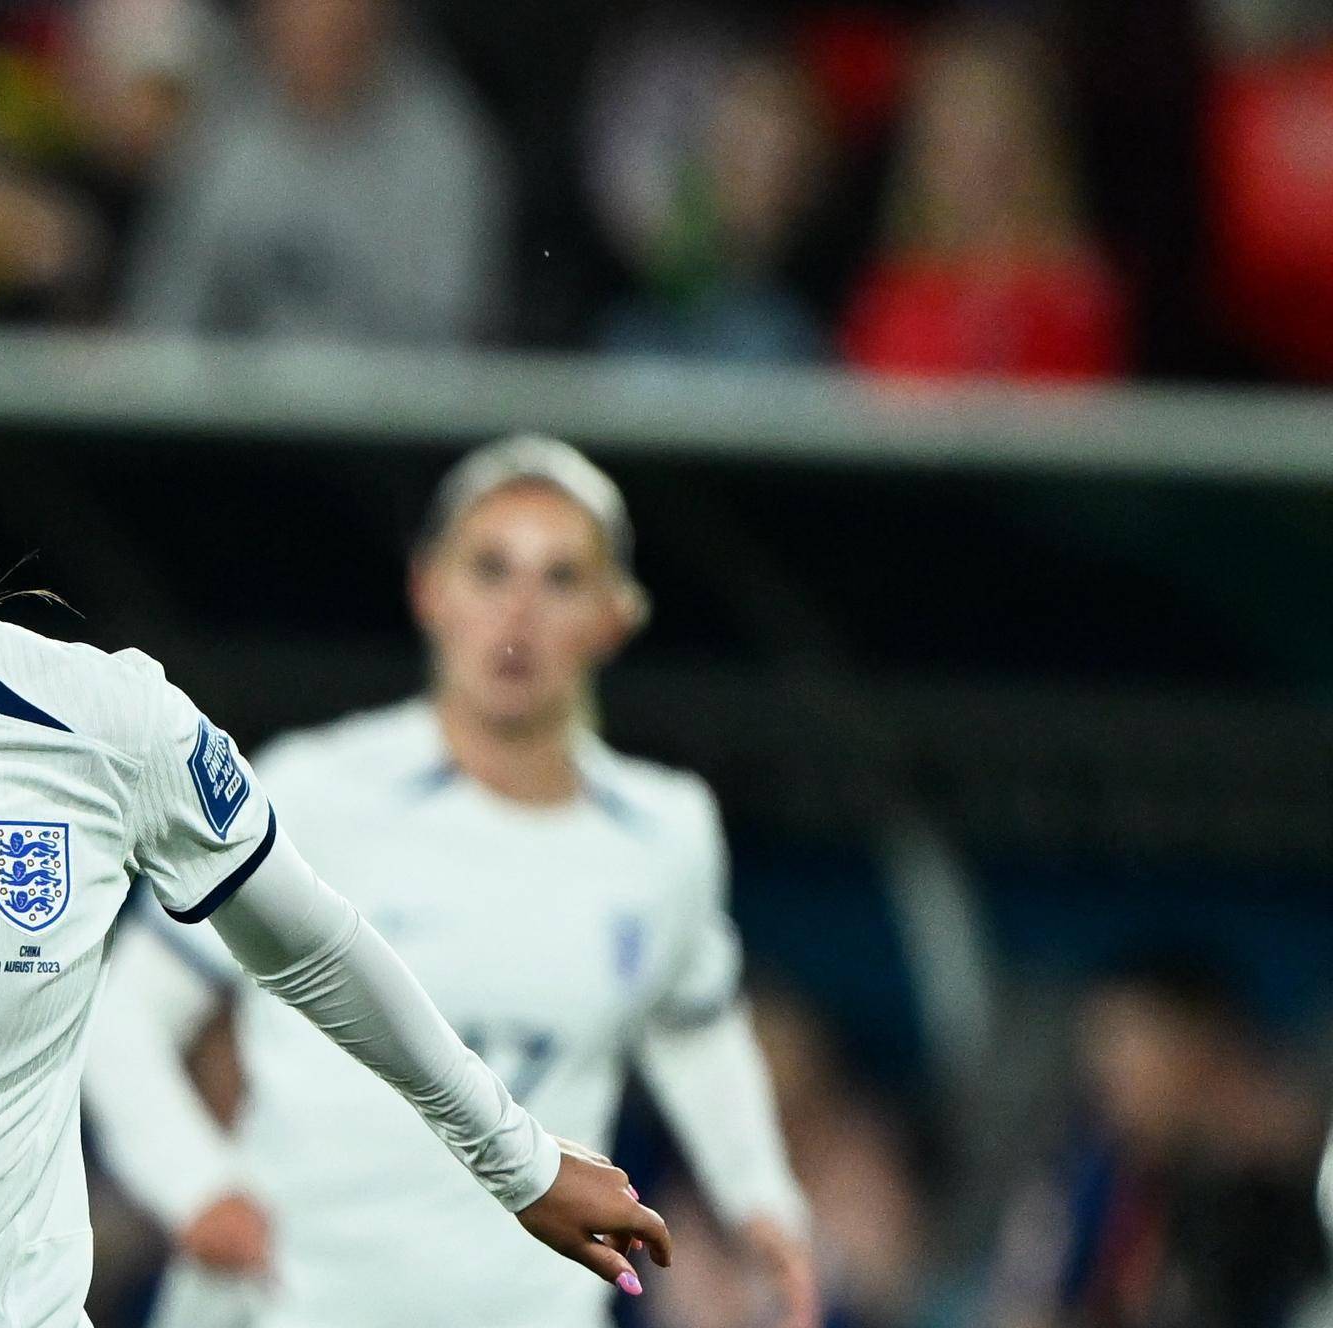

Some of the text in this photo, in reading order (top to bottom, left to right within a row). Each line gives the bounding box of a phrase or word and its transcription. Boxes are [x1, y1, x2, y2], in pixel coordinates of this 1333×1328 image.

[19, 945, 41, 958] CHINA
[4, 961, 34, 973] AUGUST
[37, 961, 61, 973] 2023
